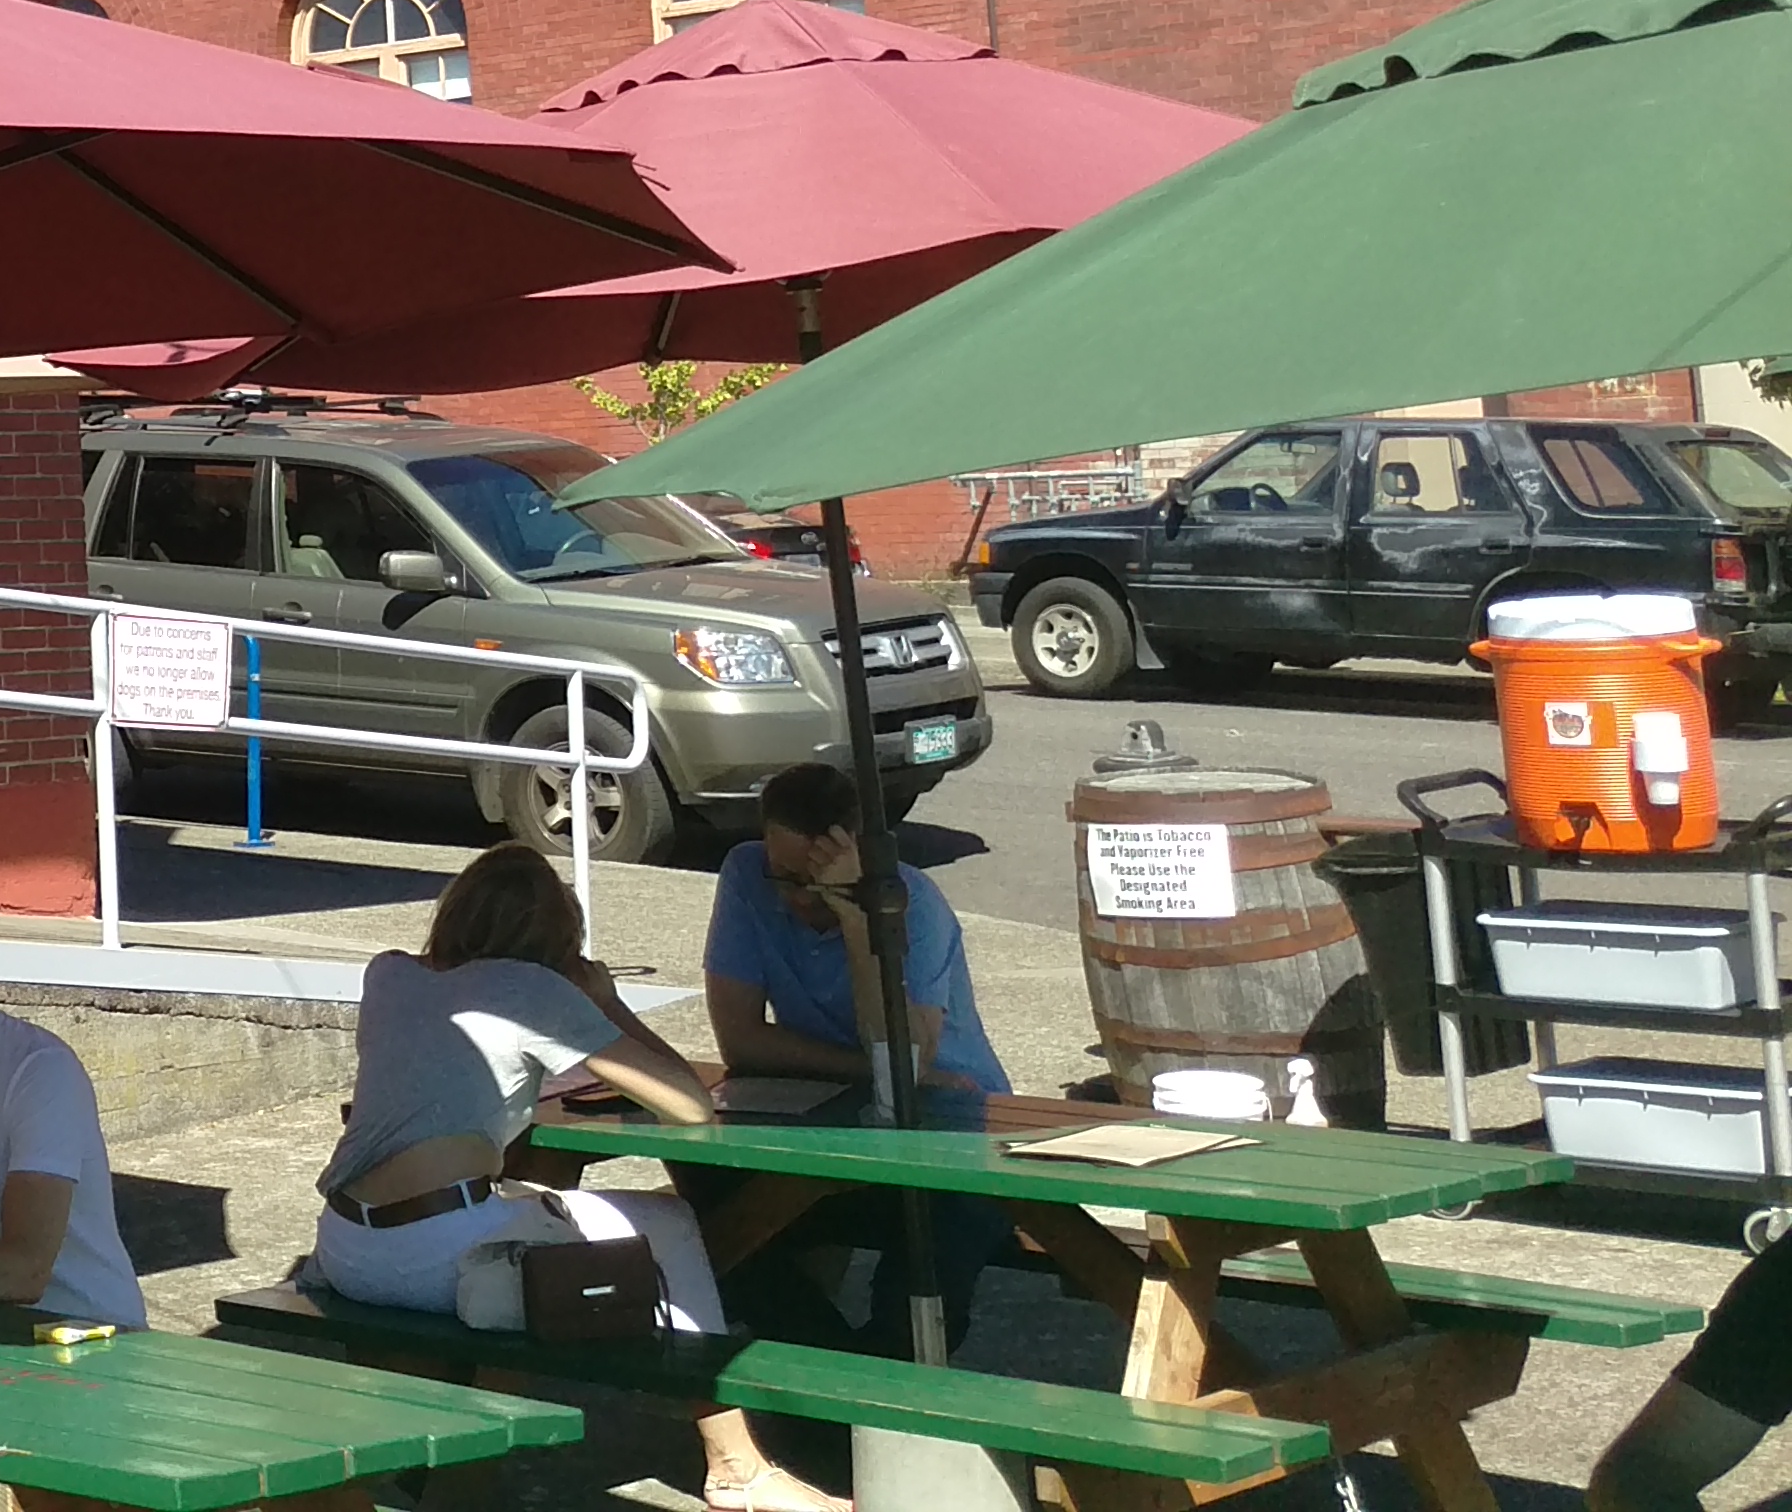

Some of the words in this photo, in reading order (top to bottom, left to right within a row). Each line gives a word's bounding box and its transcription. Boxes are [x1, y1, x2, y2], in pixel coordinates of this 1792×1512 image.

[131, 621, 151, 637] Due
[154, 626, 164, 638] to
[167, 627, 212, 642] concerns
[176, 647, 195, 660] and
[143, 703, 173, 719] Thank
[1096, 828, 1111, 842] The
[1113, 829, 1140, 842] Patio
[1143, 831, 1154, 842] is
[1158, 829, 1212, 842] Tobacco
[1100, 845, 1116, 858] and
[1118, 845, 1173, 861] Vaporizer
[1176, 845, 1205, 857] Free
[1110, 863, 1146, 876] Please
[1148, 863, 1171, 876] Use
[1175, 864, 1196, 876] the
[1120, 878, 1188, 896] Designated
[1115, 895, 1164, 914] Smoking
[1166, 897, 1196, 910] Area
